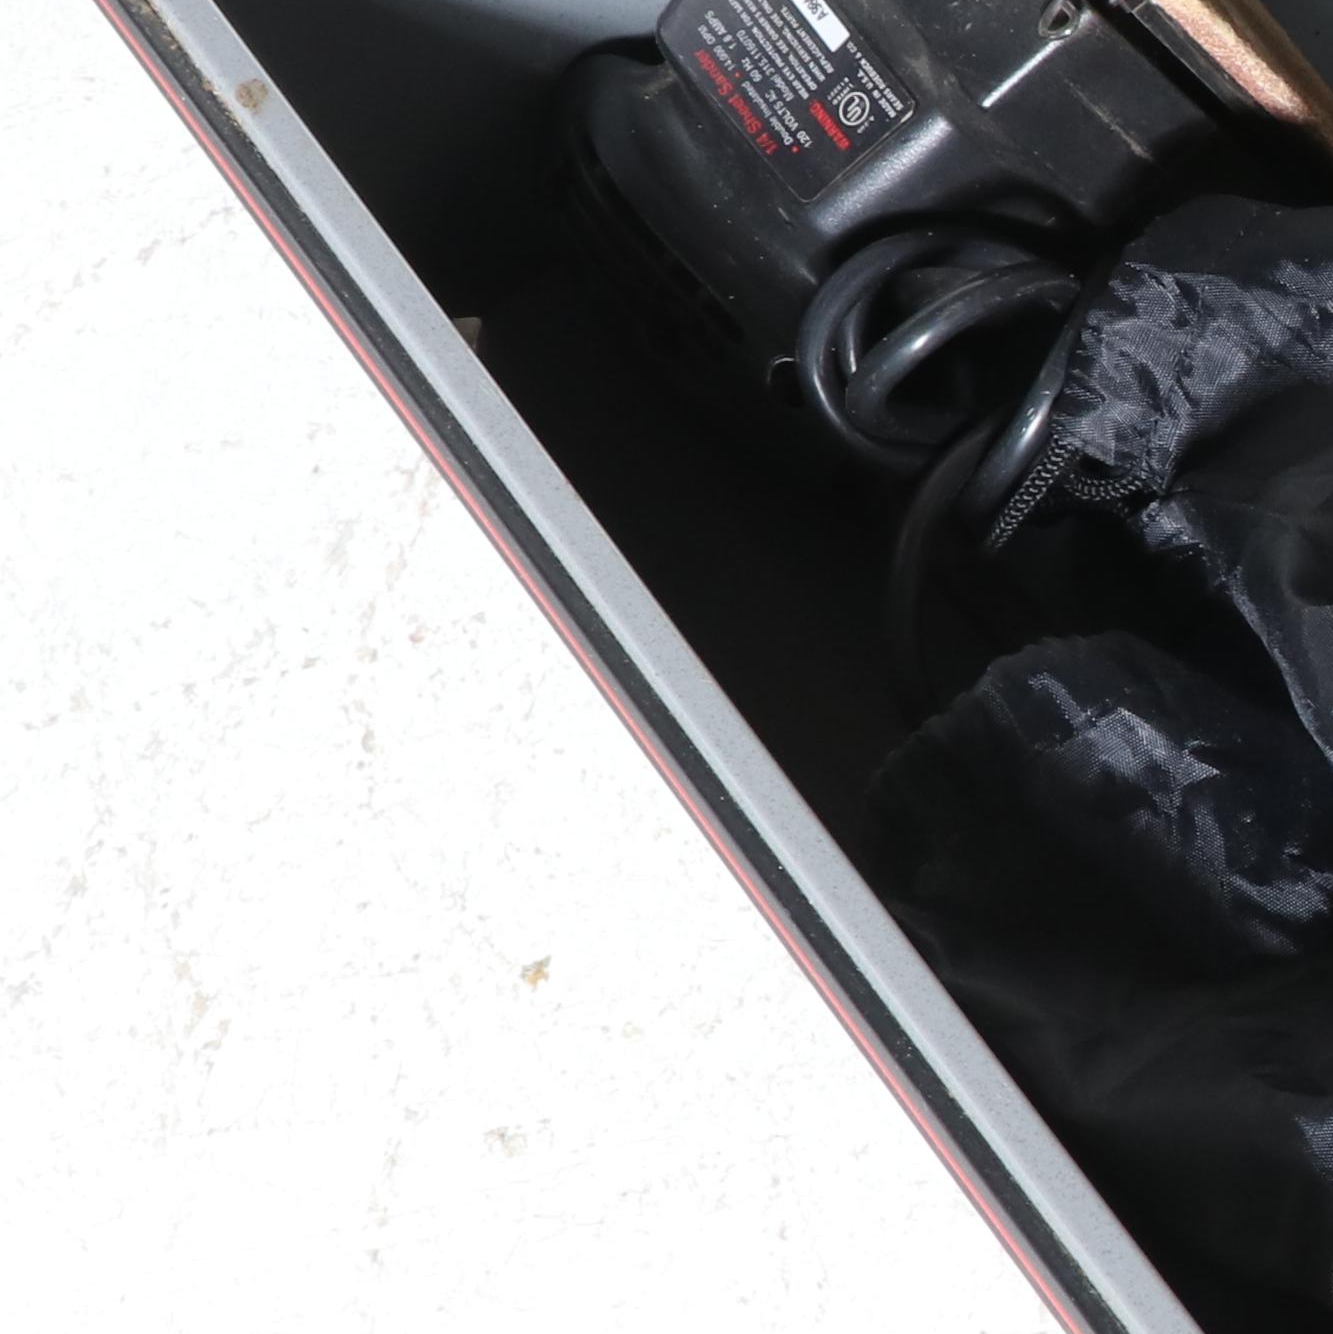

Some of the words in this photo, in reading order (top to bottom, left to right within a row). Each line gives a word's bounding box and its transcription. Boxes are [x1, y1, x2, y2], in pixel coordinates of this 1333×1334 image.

[703, 9, 727, 36] AMPS
[738, 10, 754, 27] FOR
[769, 12, 784, 27] USE
[795, 26, 834, 73] REPLACEMENT
[690, 46, 734, 96] Sander
[739, 55, 754, 71] Hz
[781, 65, 797, 83] EYE
[858, 57, 887, 90] ROEBUCK
[740, 79, 773, 117] Insulated
[763, 88, 778, 103] AC
[769, 73, 794, 101] Model
[870, 87, 881, 99] IN
[883, 87, 903, 111] SEARS
[726, 93, 763, 134] Sheet
[772, 100, 800, 131] VOLTS
[877, 96, 897, 118] MADE
[767, 114, 794, 145] Double
[796, 129, 814, 148] 120
